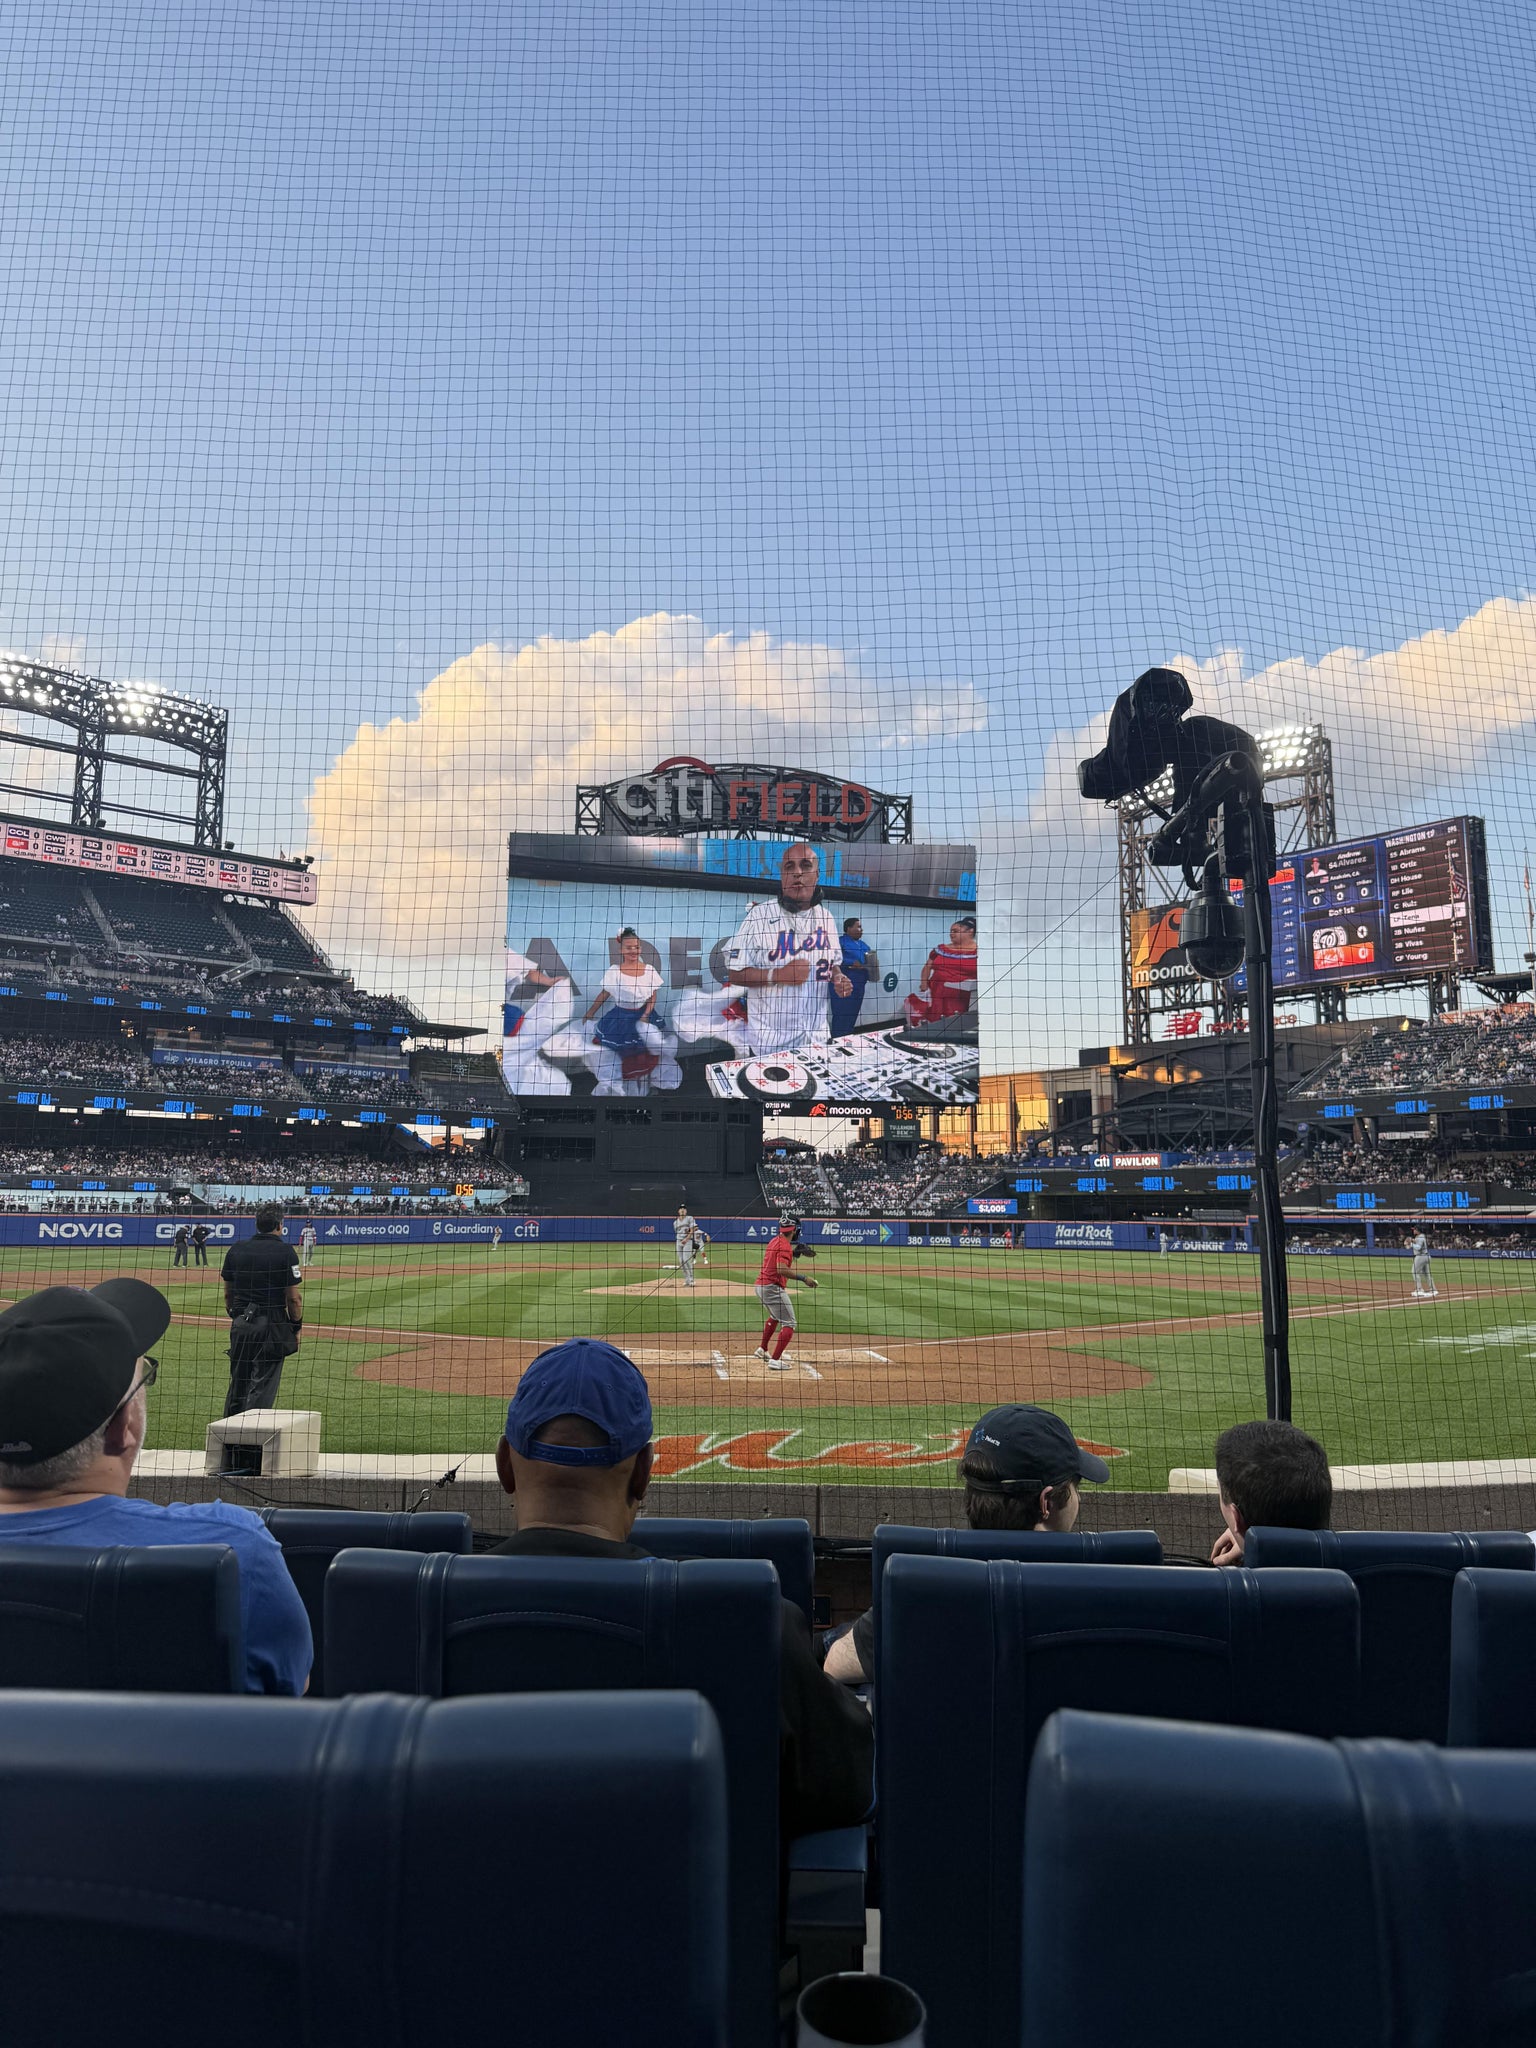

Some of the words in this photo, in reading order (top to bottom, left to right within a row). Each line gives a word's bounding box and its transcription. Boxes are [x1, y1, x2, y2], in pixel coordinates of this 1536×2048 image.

[617, 757, 716, 820] citi
[729, 780, 872, 823] FIELD
[8, 827, 29, 838] COL
[45, 834, 66, 844] CWS
[1385, 831, 1426, 848] WASHINGTON
[119, 846, 137, 855] BAL
[1337, 851, 1361, 860] Andrew
[1400, 846, 1426, 857] Abrams
[152, 852, 171, 860] NYY
[152, 862, 171, 871] TOR
[1338, 856, 1367, 868] Alvarez
[1400, 860, 1418, 869] Ortiz
[186, 868, 205, 877] HOU
[253, 868, 269, 876] TEX
[252, 878, 269, 887] ATH
[1401, 873, 1422, 882] House
[1336, 892, 1344, 900] 0
[1361, 887, 1368, 897] 0
[1402, 887, 1414, 895] Lile
[1313, 896, 1320, 905] 0
[1402, 900, 1418, 908] Ruiz
[1357, 925, 1368, 938] 0
[1405, 940, 1424, 948] Vivas
[1358, 947, 1368, 959] 0
[1405, 952, 1428, 961] Young
[1136, 963, 1195, 982] moomo
[184, 1056, 219, 1066] MILAGRO
[221, 1059, 252, 1068] TEQUILA
[1469, 1096, 1490, 1109] GUEST
[1494, 1095, 1504, 1108] DJ
[829, 1106, 872, 1115] moomoo
[1395, 1101, 1415, 1114] GUEST
[1418, 1101, 1428, 1113] DJ
[896, 1109, 913, 1120] 0:56
[1094, 1154, 1110, 1168] citi
[1115, 1156, 1159, 1168] PAVILION
[1142, 1177, 1162, 1191] GUEST
[1164, 1177, 1174, 1190] DJ
[1216, 1176, 1239, 1190] GUEST
[1241, 1175, 1251, 1189] DJ
[455, 1184, 474, 1197] 0:56
[1336, 1193, 1361, 1208] GUEST
[1364, 1193, 1376, 1208] DJ
[1426, 1192, 1452, 1208] GUEST
[1456, 1192, 1469, 1208] DJ
[978, 1204, 1007, 1213] $2,005
[39, 1222, 123, 1239] NOVIG
[344, 1225, 387, 1236] Invesco
[387, 1225, 410, 1236] QQQ
[444, 1223, 494, 1234] Guardian
[514, 1220, 540, 1238] citi
[840, 1228, 878, 1236] HAUGLAND
[1055, 1224, 1085, 1237] Hard
[1085, 1225, 1114, 1240] Rock
[840, 1235, 864, 1243] GROUP
[907, 1236, 923, 1245] 380
[929, 1236, 952, 1245] GOYA
[959, 1236, 982, 1245] GOYA
[1285, 1246, 1332, 1255] ADILLAC
[1490, 1250, 1536, 1258] CADILL
